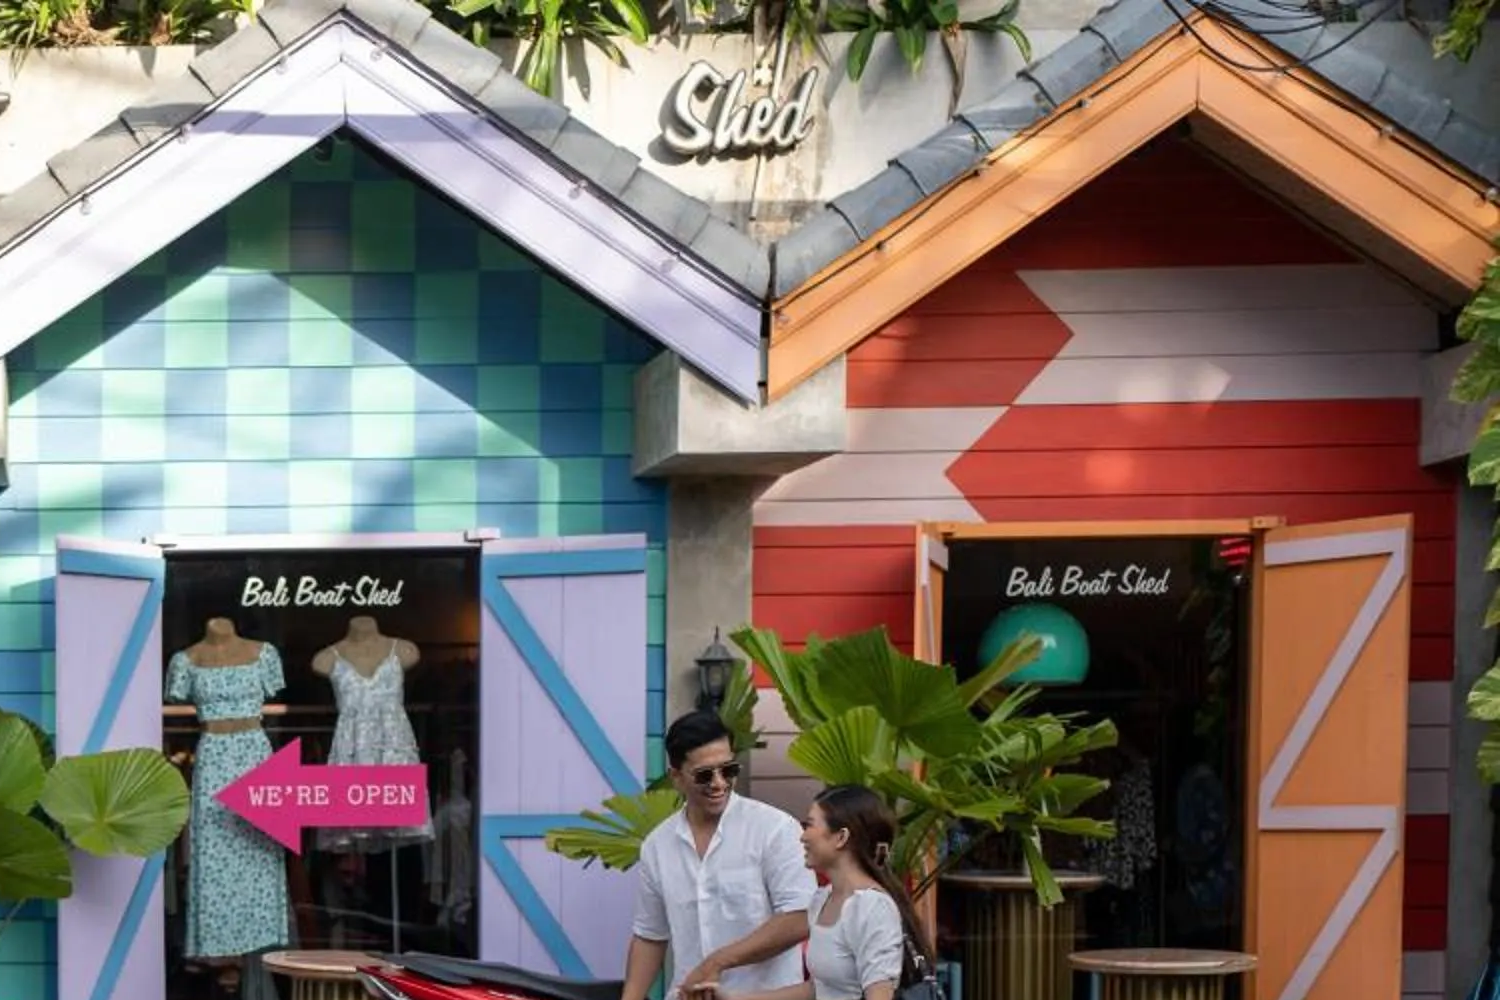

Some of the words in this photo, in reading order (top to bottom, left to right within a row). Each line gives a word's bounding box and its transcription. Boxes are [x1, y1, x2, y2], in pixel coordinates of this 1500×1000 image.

[663, 60, 819, 153] Shed
[241, 576, 290, 607] Bali
[294, 575, 352, 606] Boat
[351, 575, 404, 606] Shed
[1006, 565, 1055, 597] Bali
[1060, 565, 1116, 595] Boat
[1118, 563, 1171, 595] Shed
[347, 784, 416, 805] OPEN
